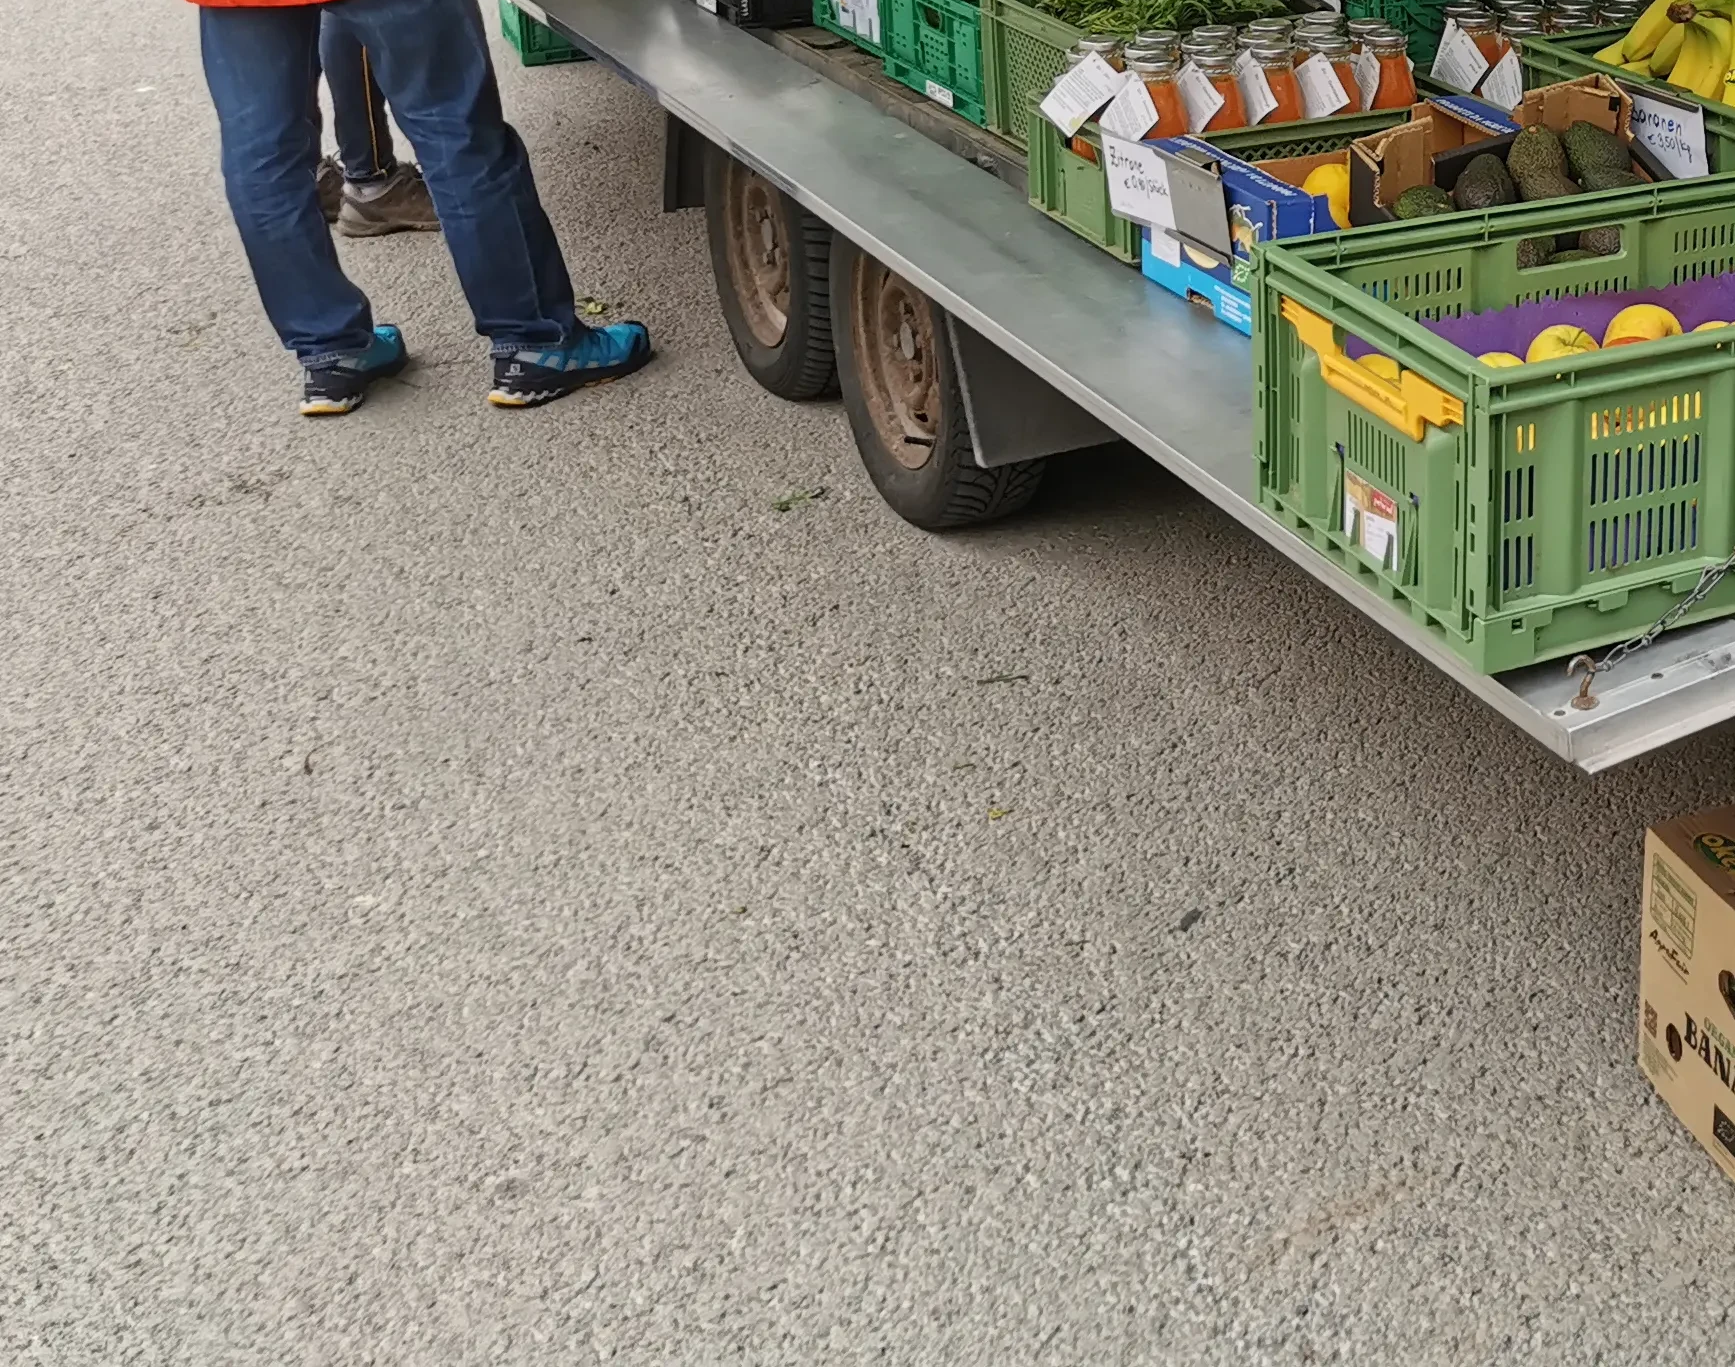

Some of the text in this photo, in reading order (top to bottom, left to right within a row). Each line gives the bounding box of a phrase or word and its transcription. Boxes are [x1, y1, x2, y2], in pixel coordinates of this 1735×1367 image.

[1647, 134, 1657, 146] €
[1108, 145, 1145, 176] Zitrone
[1648, 928, 1690, 975] AgroFair
